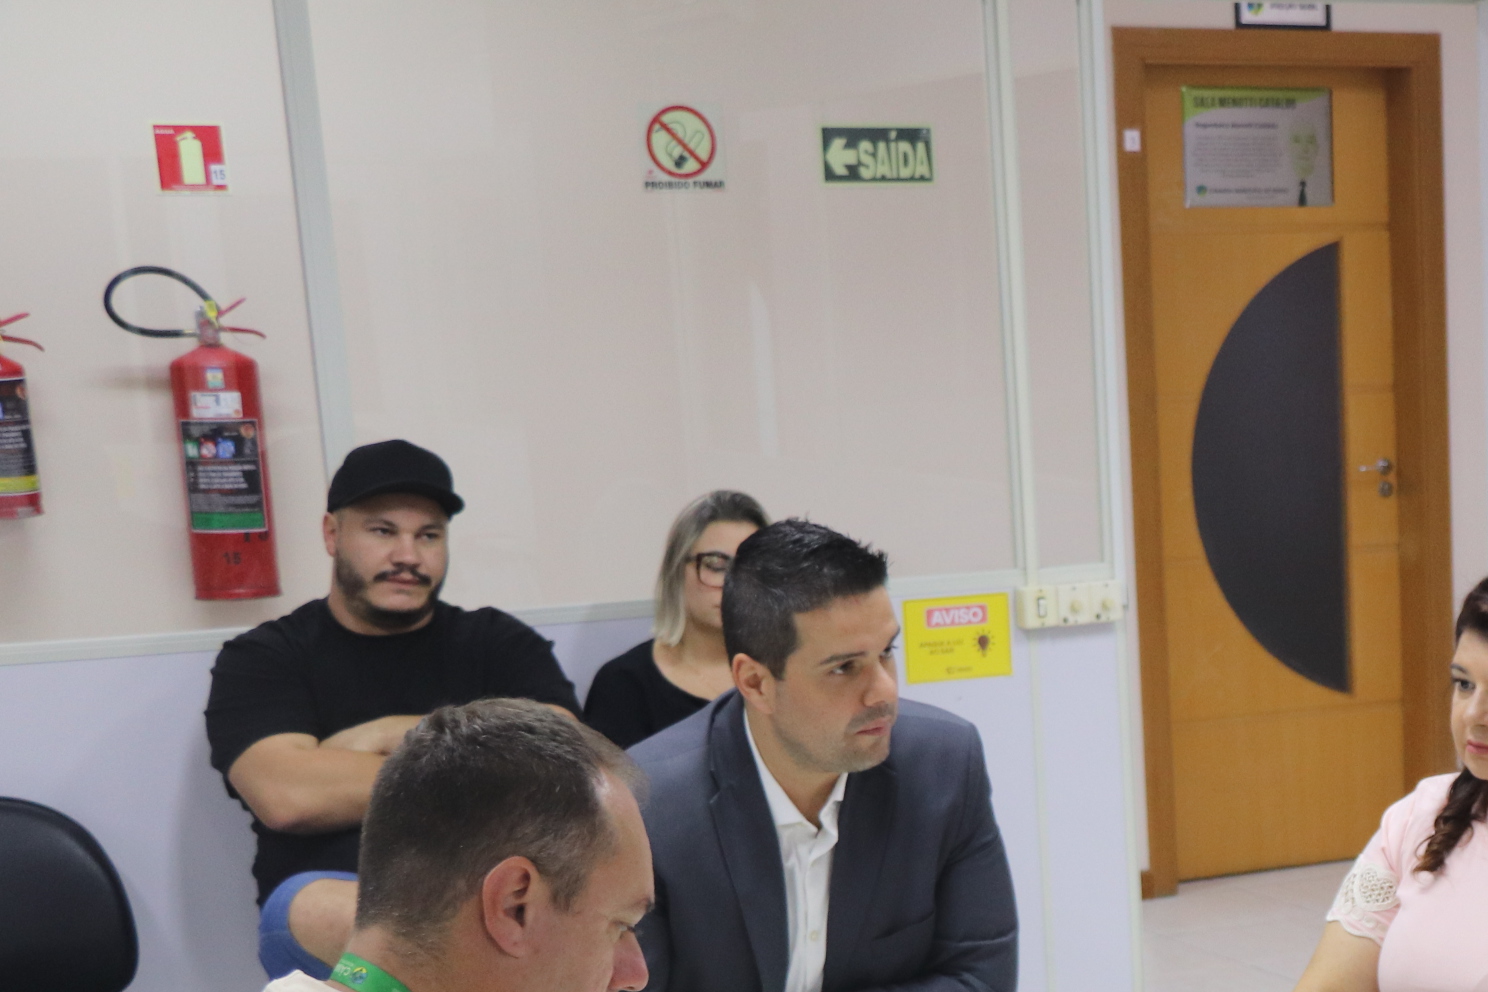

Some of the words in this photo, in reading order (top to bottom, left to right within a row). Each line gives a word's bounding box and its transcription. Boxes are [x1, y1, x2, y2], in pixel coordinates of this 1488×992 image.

[858, 130, 931, 180] SAÍDA
[213, 169, 226, 180] 15
[645, 181, 690, 190] PROIBIDO
[693, 181, 725, 190] FUMAR
[223, 552, 242, 565] 15
[931, 607, 984, 626] AVISO
